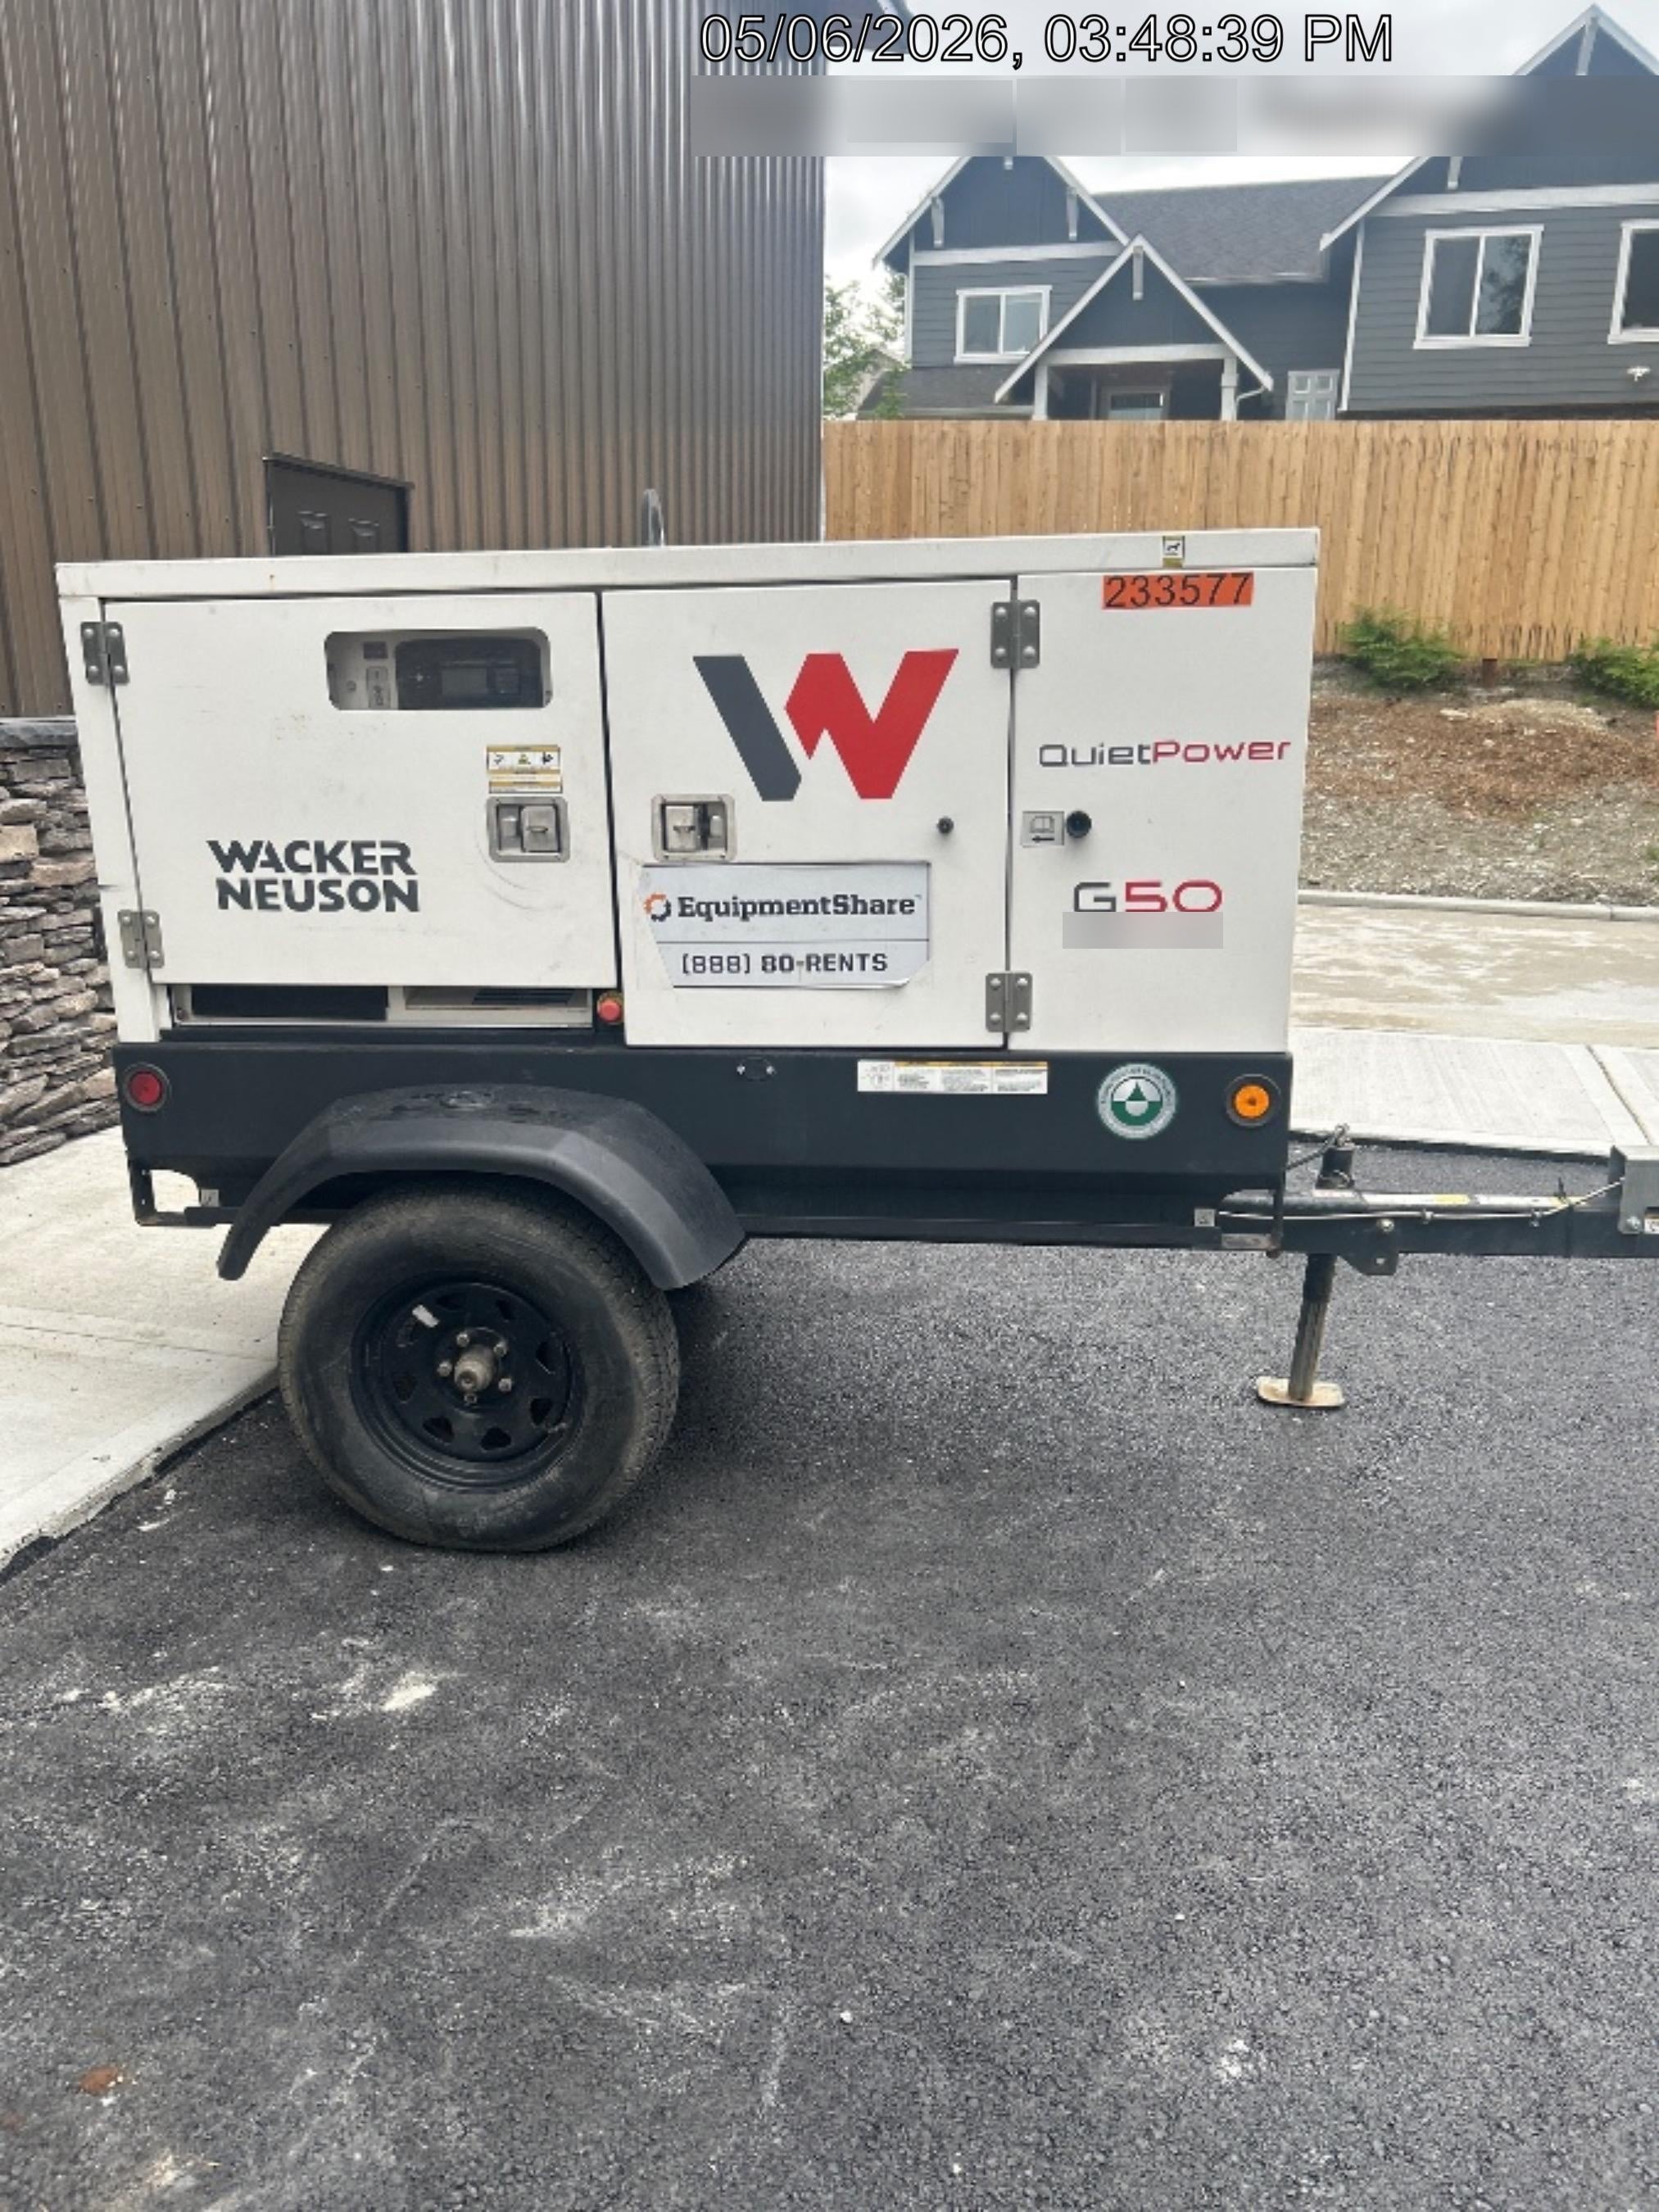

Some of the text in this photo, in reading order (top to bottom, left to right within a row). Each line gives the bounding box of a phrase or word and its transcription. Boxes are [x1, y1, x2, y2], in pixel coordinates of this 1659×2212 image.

[1105, 573, 1251, 608] 233577
[1039, 740, 1291, 767] QuietPower
[206, 839, 418, 876] WACKER
[215, 877, 419, 913] NEUSON
[677, 894, 916, 922] EquipmentShare
[1073, 879, 1222, 913] G50
[682, 953, 888, 975] (888) 80-RENTS
